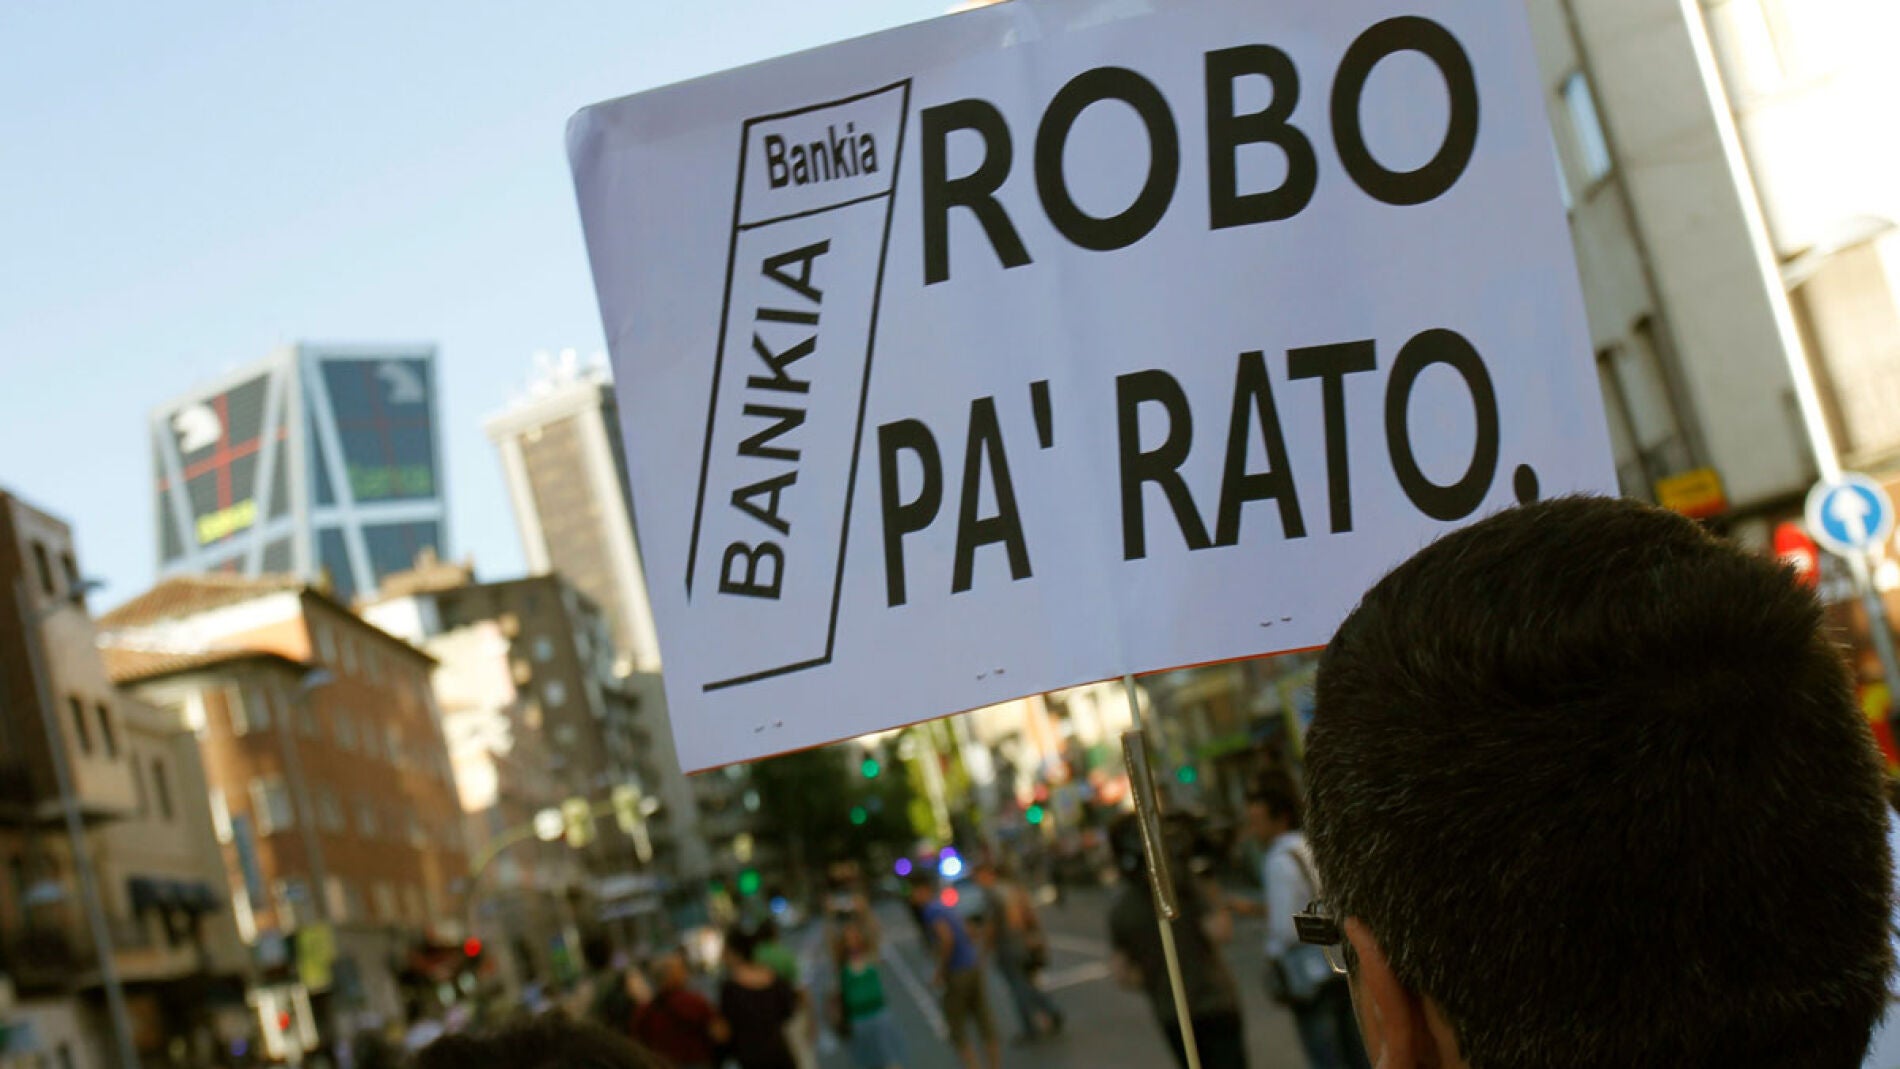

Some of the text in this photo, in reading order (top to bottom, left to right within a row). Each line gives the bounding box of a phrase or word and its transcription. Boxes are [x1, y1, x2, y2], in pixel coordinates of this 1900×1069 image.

[764, 121, 879, 190] Bankia
[920, 15, 1480, 287] ROBO
[718, 238, 831, 600] BANKIA
[877, 379, 1054, 608] PA'
